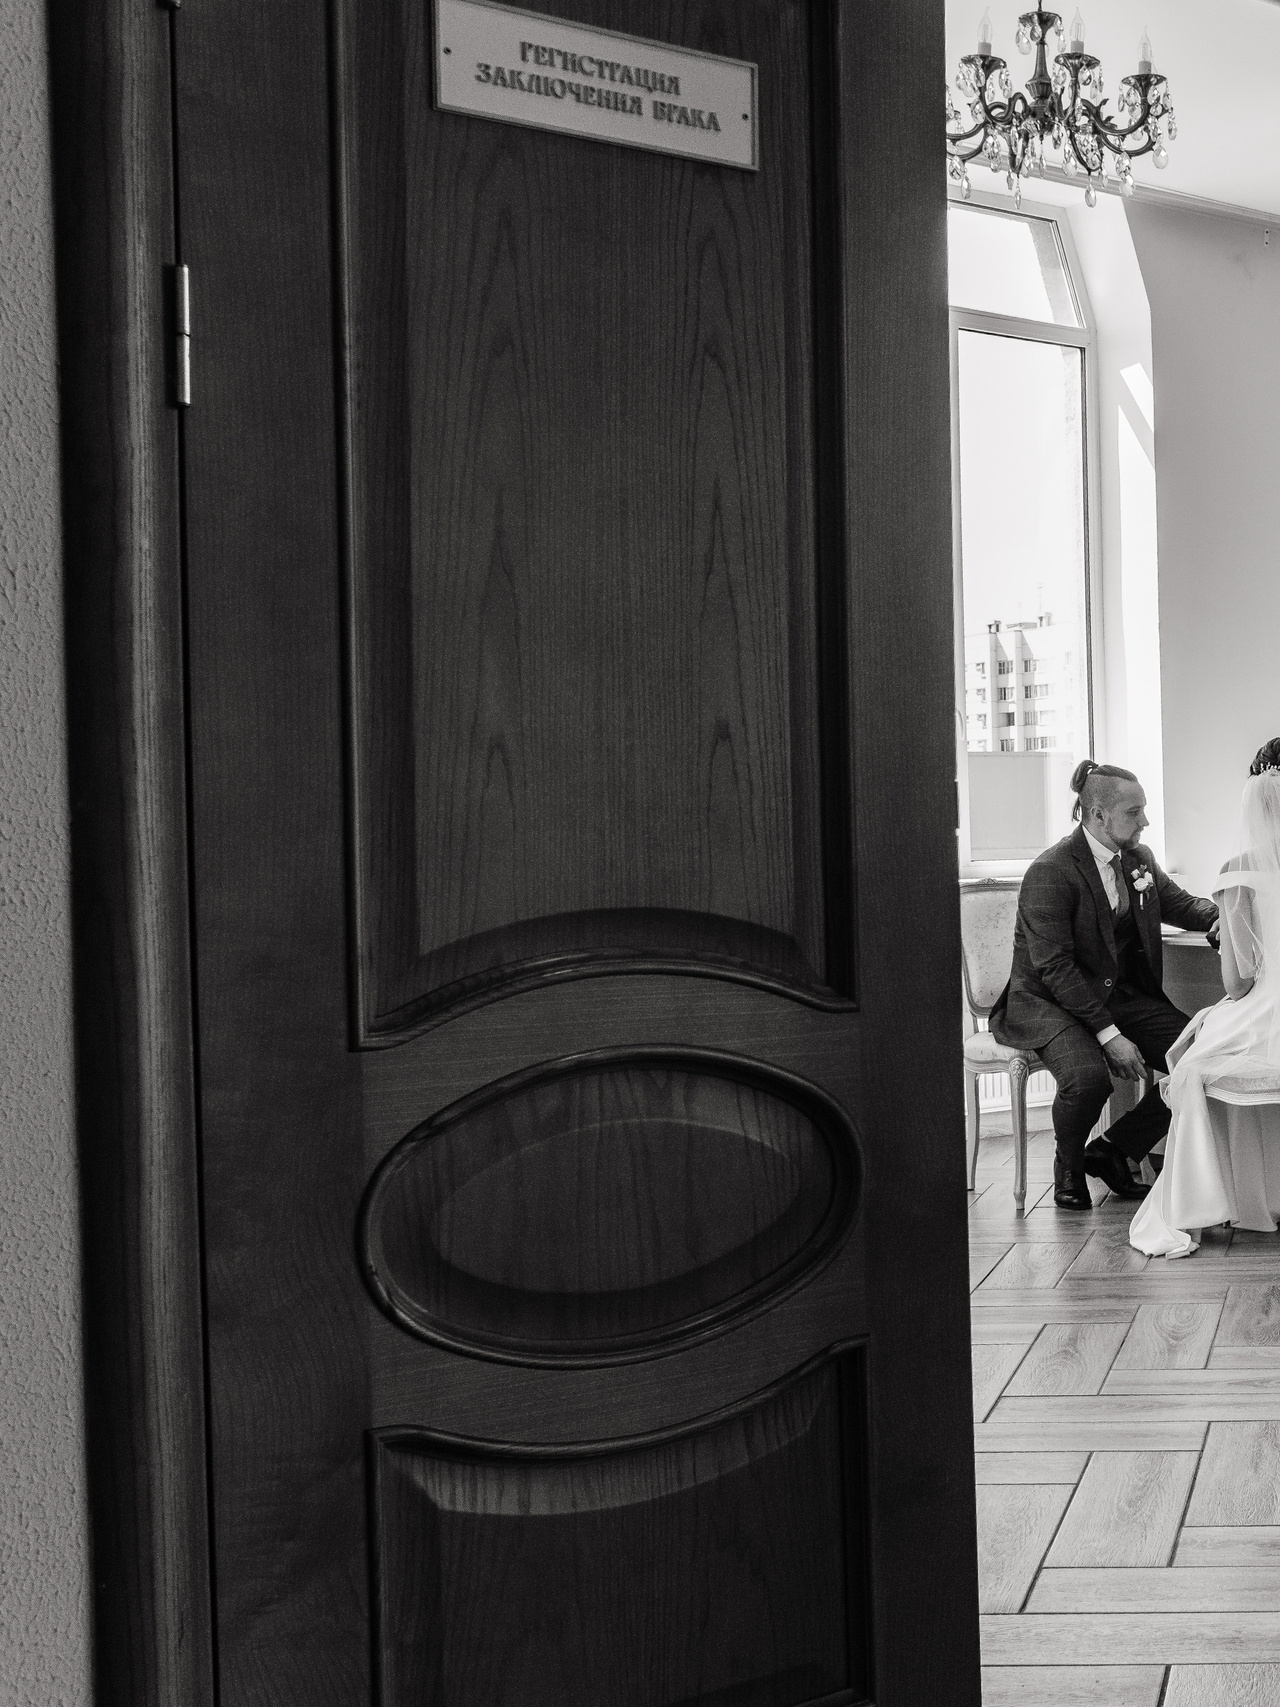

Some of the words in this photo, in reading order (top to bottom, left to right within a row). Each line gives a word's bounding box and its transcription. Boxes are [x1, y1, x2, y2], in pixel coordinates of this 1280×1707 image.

[475, 62, 643, 116] ЗАКЛЮЧЕНИЯ
[653, 100, 721, 132] БРАКА
[519, 41, 682, 96] РЕГИСТРАЦИЯ
